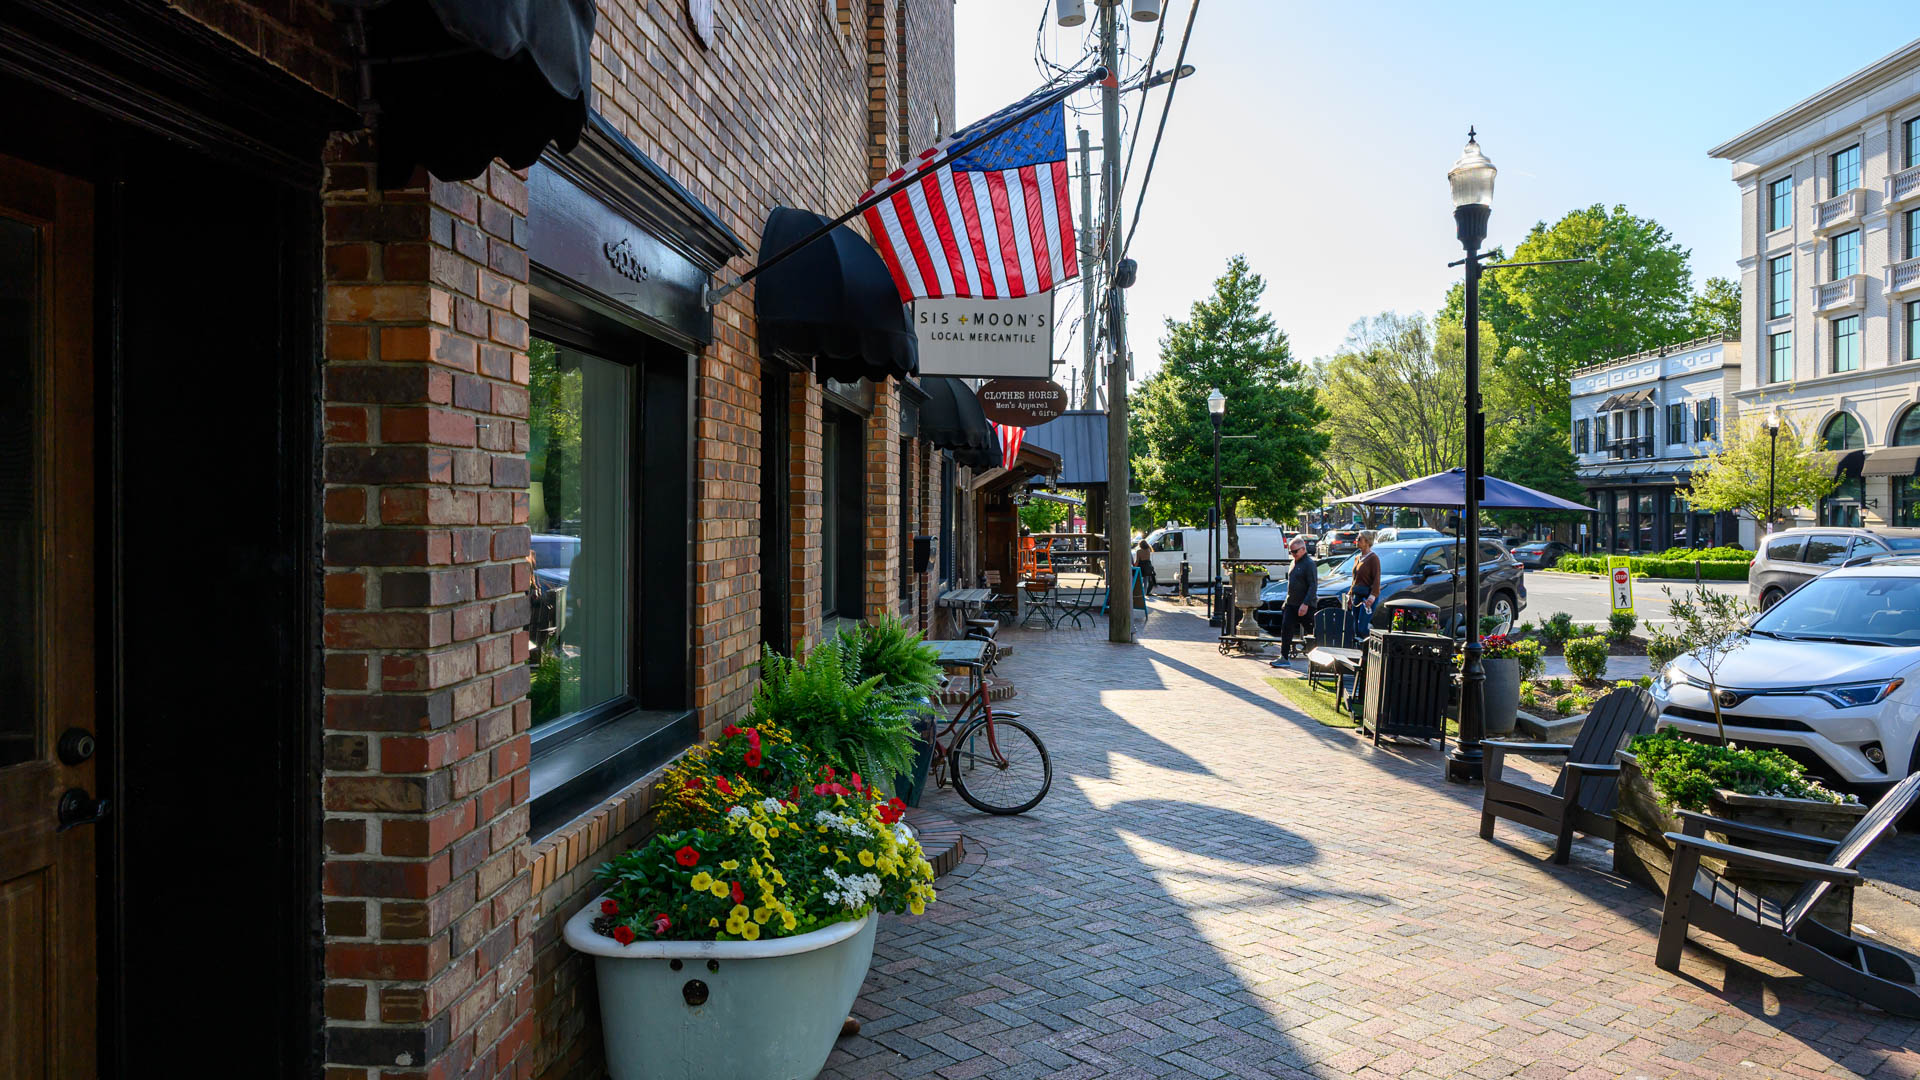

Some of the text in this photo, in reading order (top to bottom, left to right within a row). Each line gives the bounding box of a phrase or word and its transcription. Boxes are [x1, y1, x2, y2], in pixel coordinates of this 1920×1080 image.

[920, 311, 949, 324] SIS
[973, 312, 1046, 327] MOON'S
[931, 332, 1036, 343] LOCAL MERCANTILE
[984, 391, 1059, 399] CLOTHES HORSE
